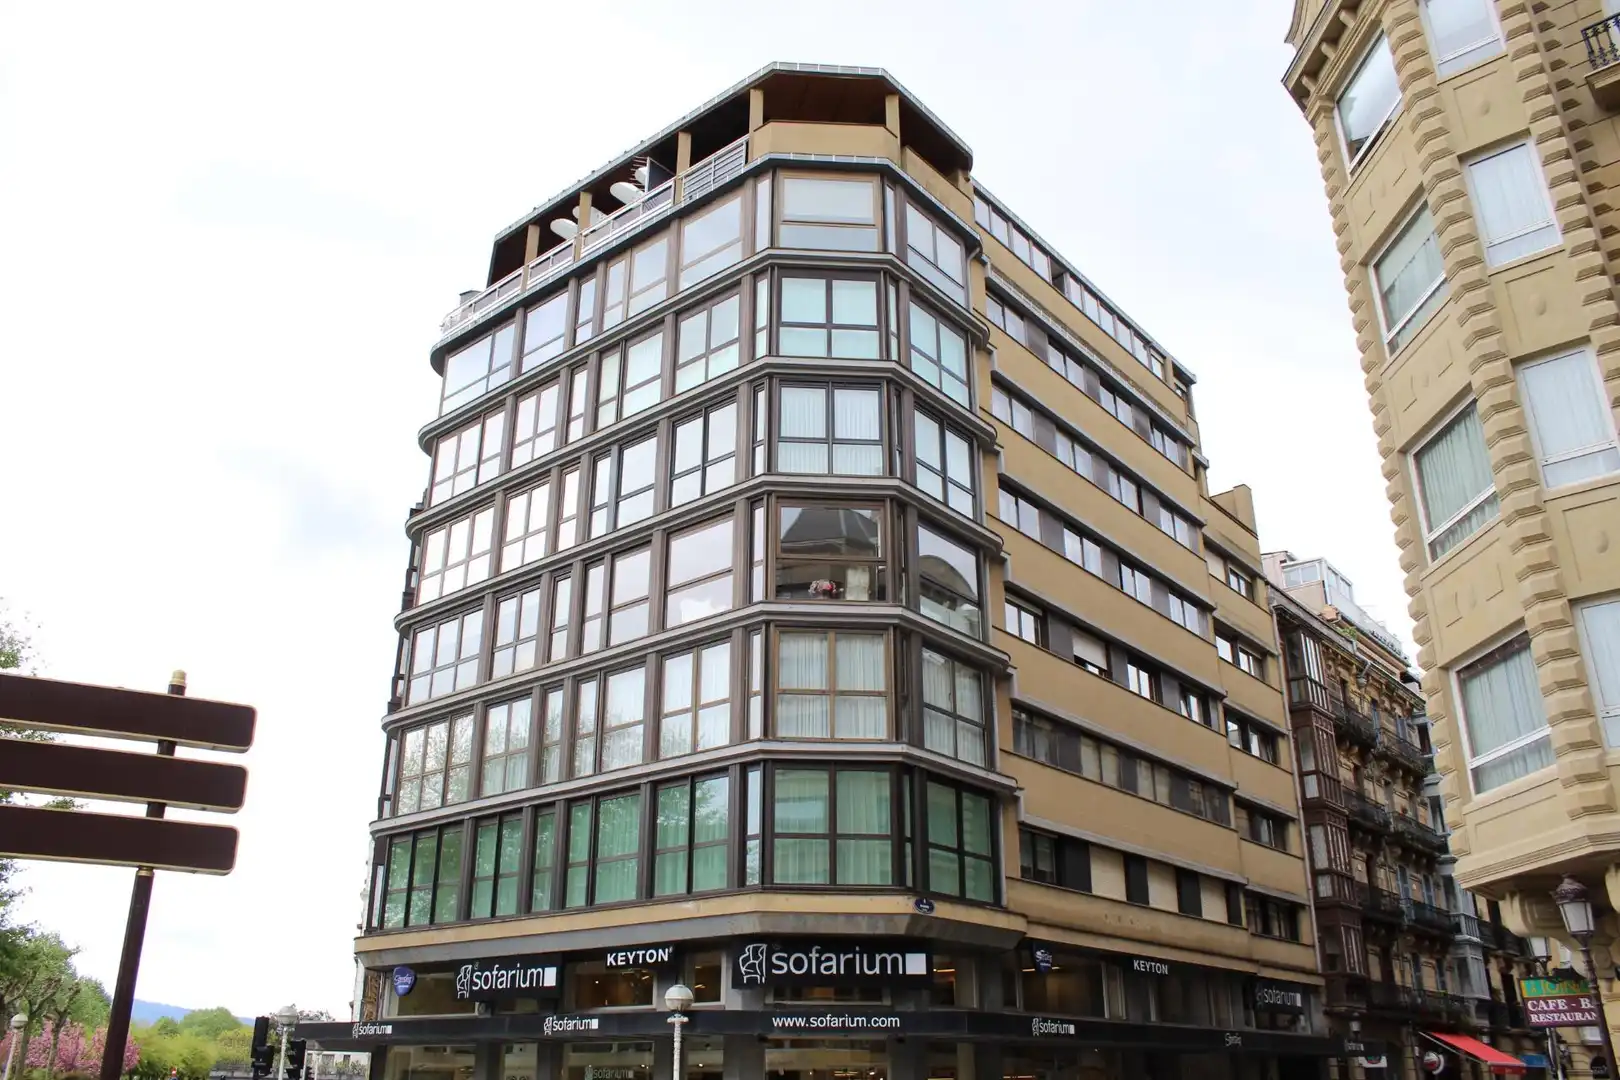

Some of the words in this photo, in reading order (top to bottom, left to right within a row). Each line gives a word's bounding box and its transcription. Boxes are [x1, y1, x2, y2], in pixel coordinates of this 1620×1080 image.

[606, 947, 669, 967] KEYTON
[771, 945, 903, 975] sofarium
[1133, 959, 1169, 975] KEYTON
[471, 962, 543, 991] sofarium
[1263, 985, 1297, 1006] sofarium
[1527, 998, 1568, 1011] CAFE
[1579, 997, 1594, 1009] B
[358, 1022, 387, 1035] sofarium
[552, 1015, 592, 1032] sofarium
[772, 1013, 900, 1028] www.sofarium.com
[1039, 1019, 1071, 1035] sofarium
